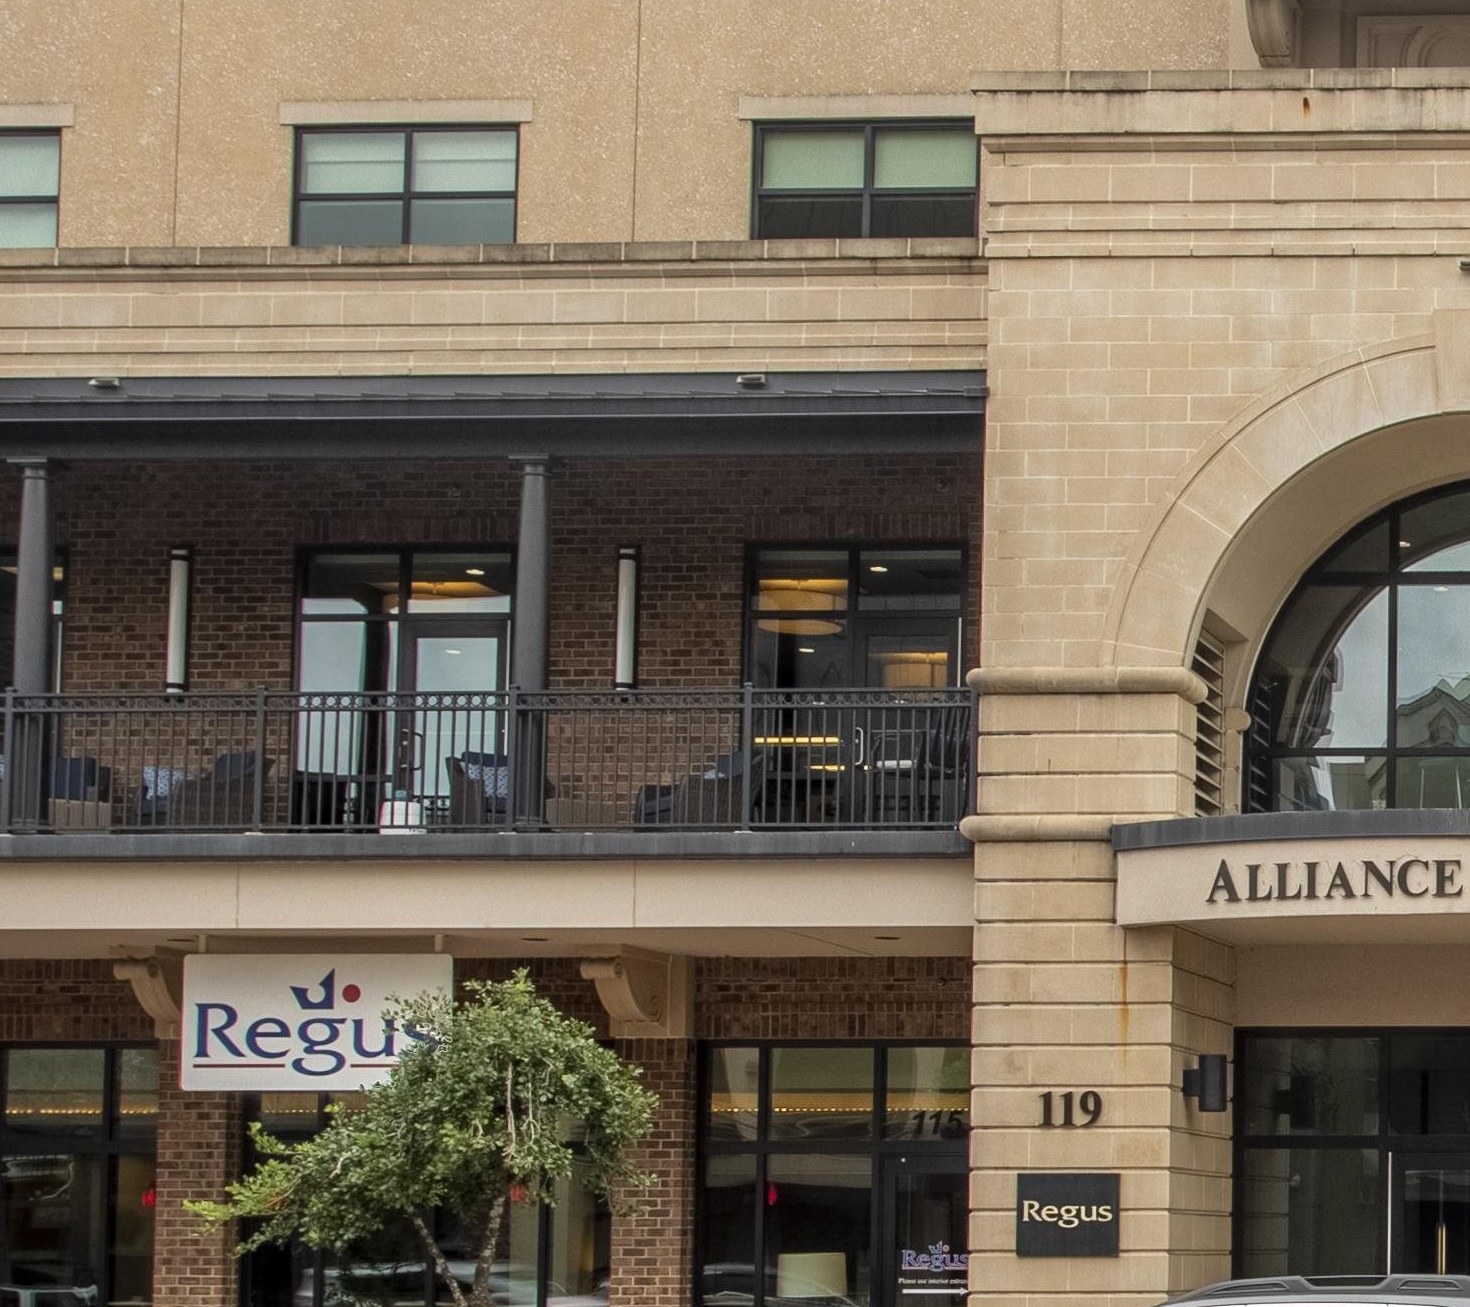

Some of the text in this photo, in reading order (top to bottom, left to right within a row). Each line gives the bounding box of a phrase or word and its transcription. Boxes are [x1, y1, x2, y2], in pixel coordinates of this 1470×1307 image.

[1205, 857, 1464, 905] ALLIANCE
[913, 1109, 963, 1139] 115
[1038, 1090, 1103, 1128] 119
[1021, 1200, 1114, 1229] Regus
